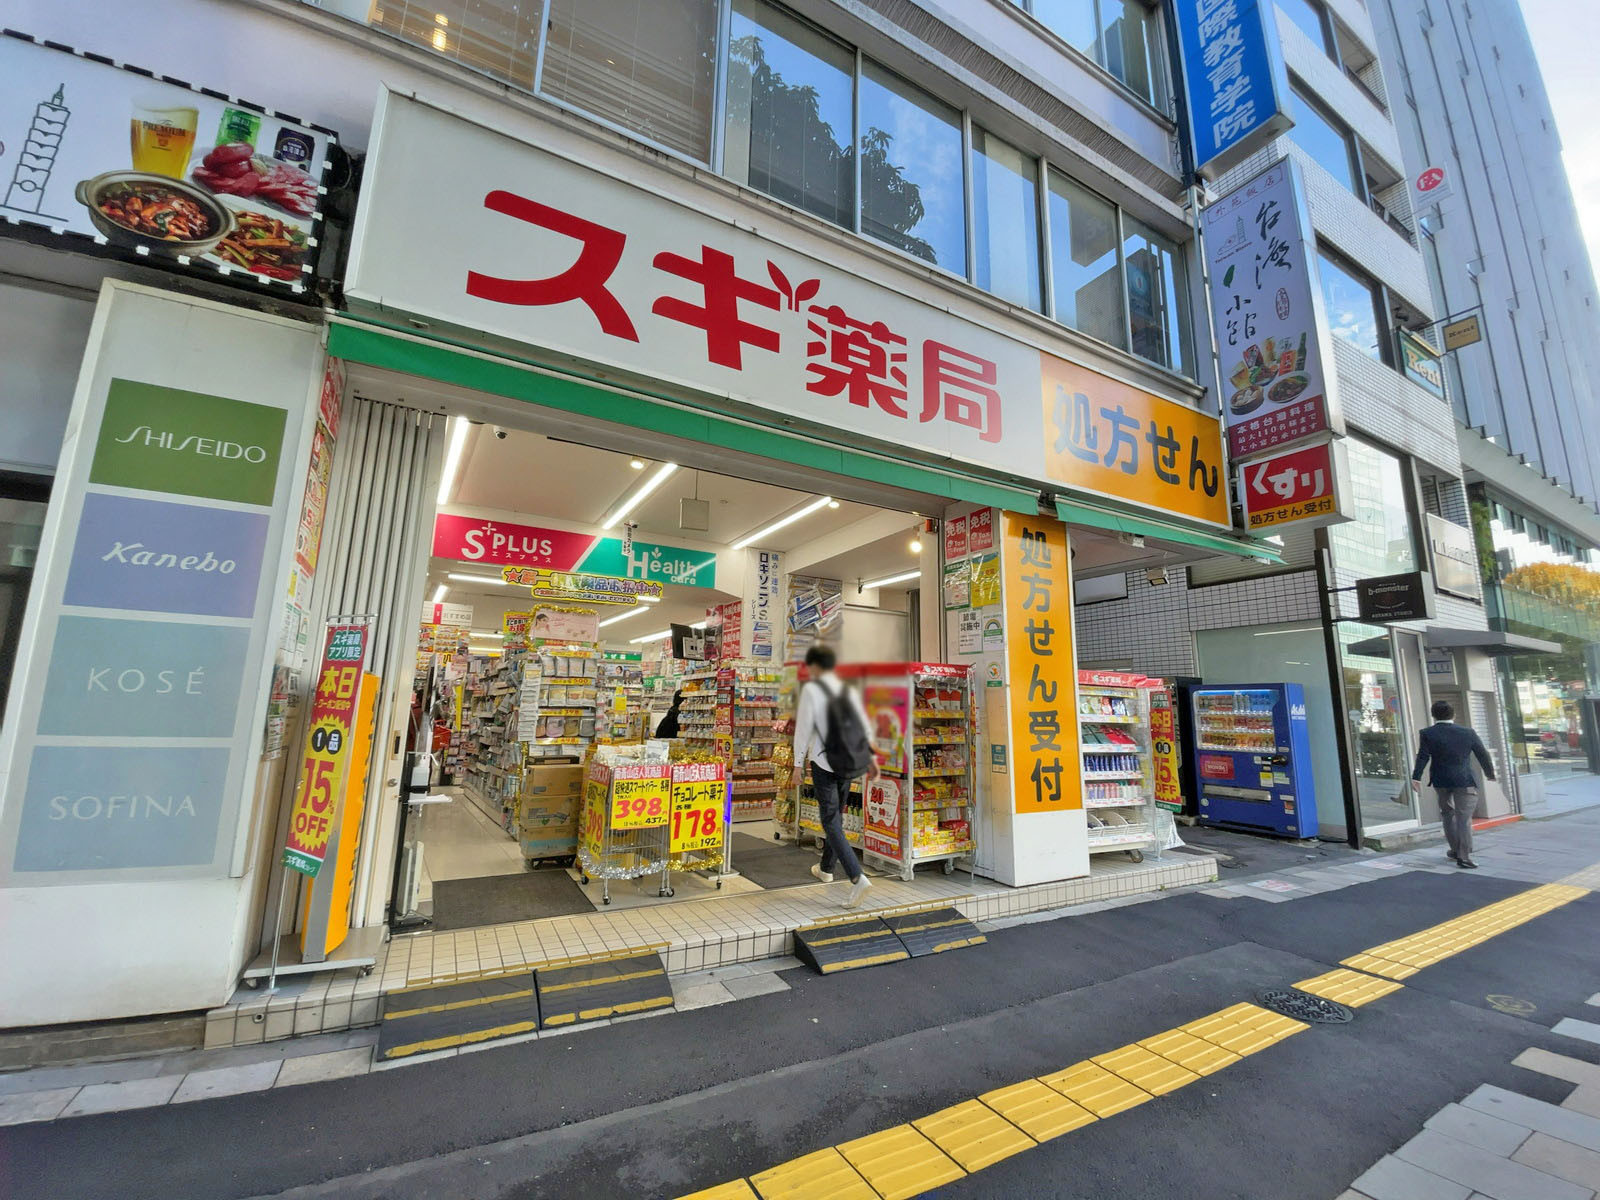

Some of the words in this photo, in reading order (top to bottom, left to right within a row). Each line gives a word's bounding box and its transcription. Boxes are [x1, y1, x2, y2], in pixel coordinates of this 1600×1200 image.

[143, 120, 187, 136] PREMIUM
[466, 190, 1001, 443] スギ薬局
[115, 425, 267, 464] SHISEIDO
[1052, 384, 1218, 497] 処方せん
[1252, 462, 1326, 499] くすり
[1250, 499, 1333, 526] 処方せん受付
[103, 541, 237, 575] Kanebo
[492, 551, 552, 563] エスプラス
[627, 550, 698, 578] Health
[671, 574, 697, 584] care
[328, 646, 361, 657] アプリ限定
[1019, 527, 1064, 802] 処方せん受付
[87, 666, 206, 695] KOSÉ
[320, 666, 358, 698] 本日
[674, 784, 724, 803] チョコレート菓子
[49, 795, 197, 821] SOFINA
[295, 812, 328, 838] OFF
